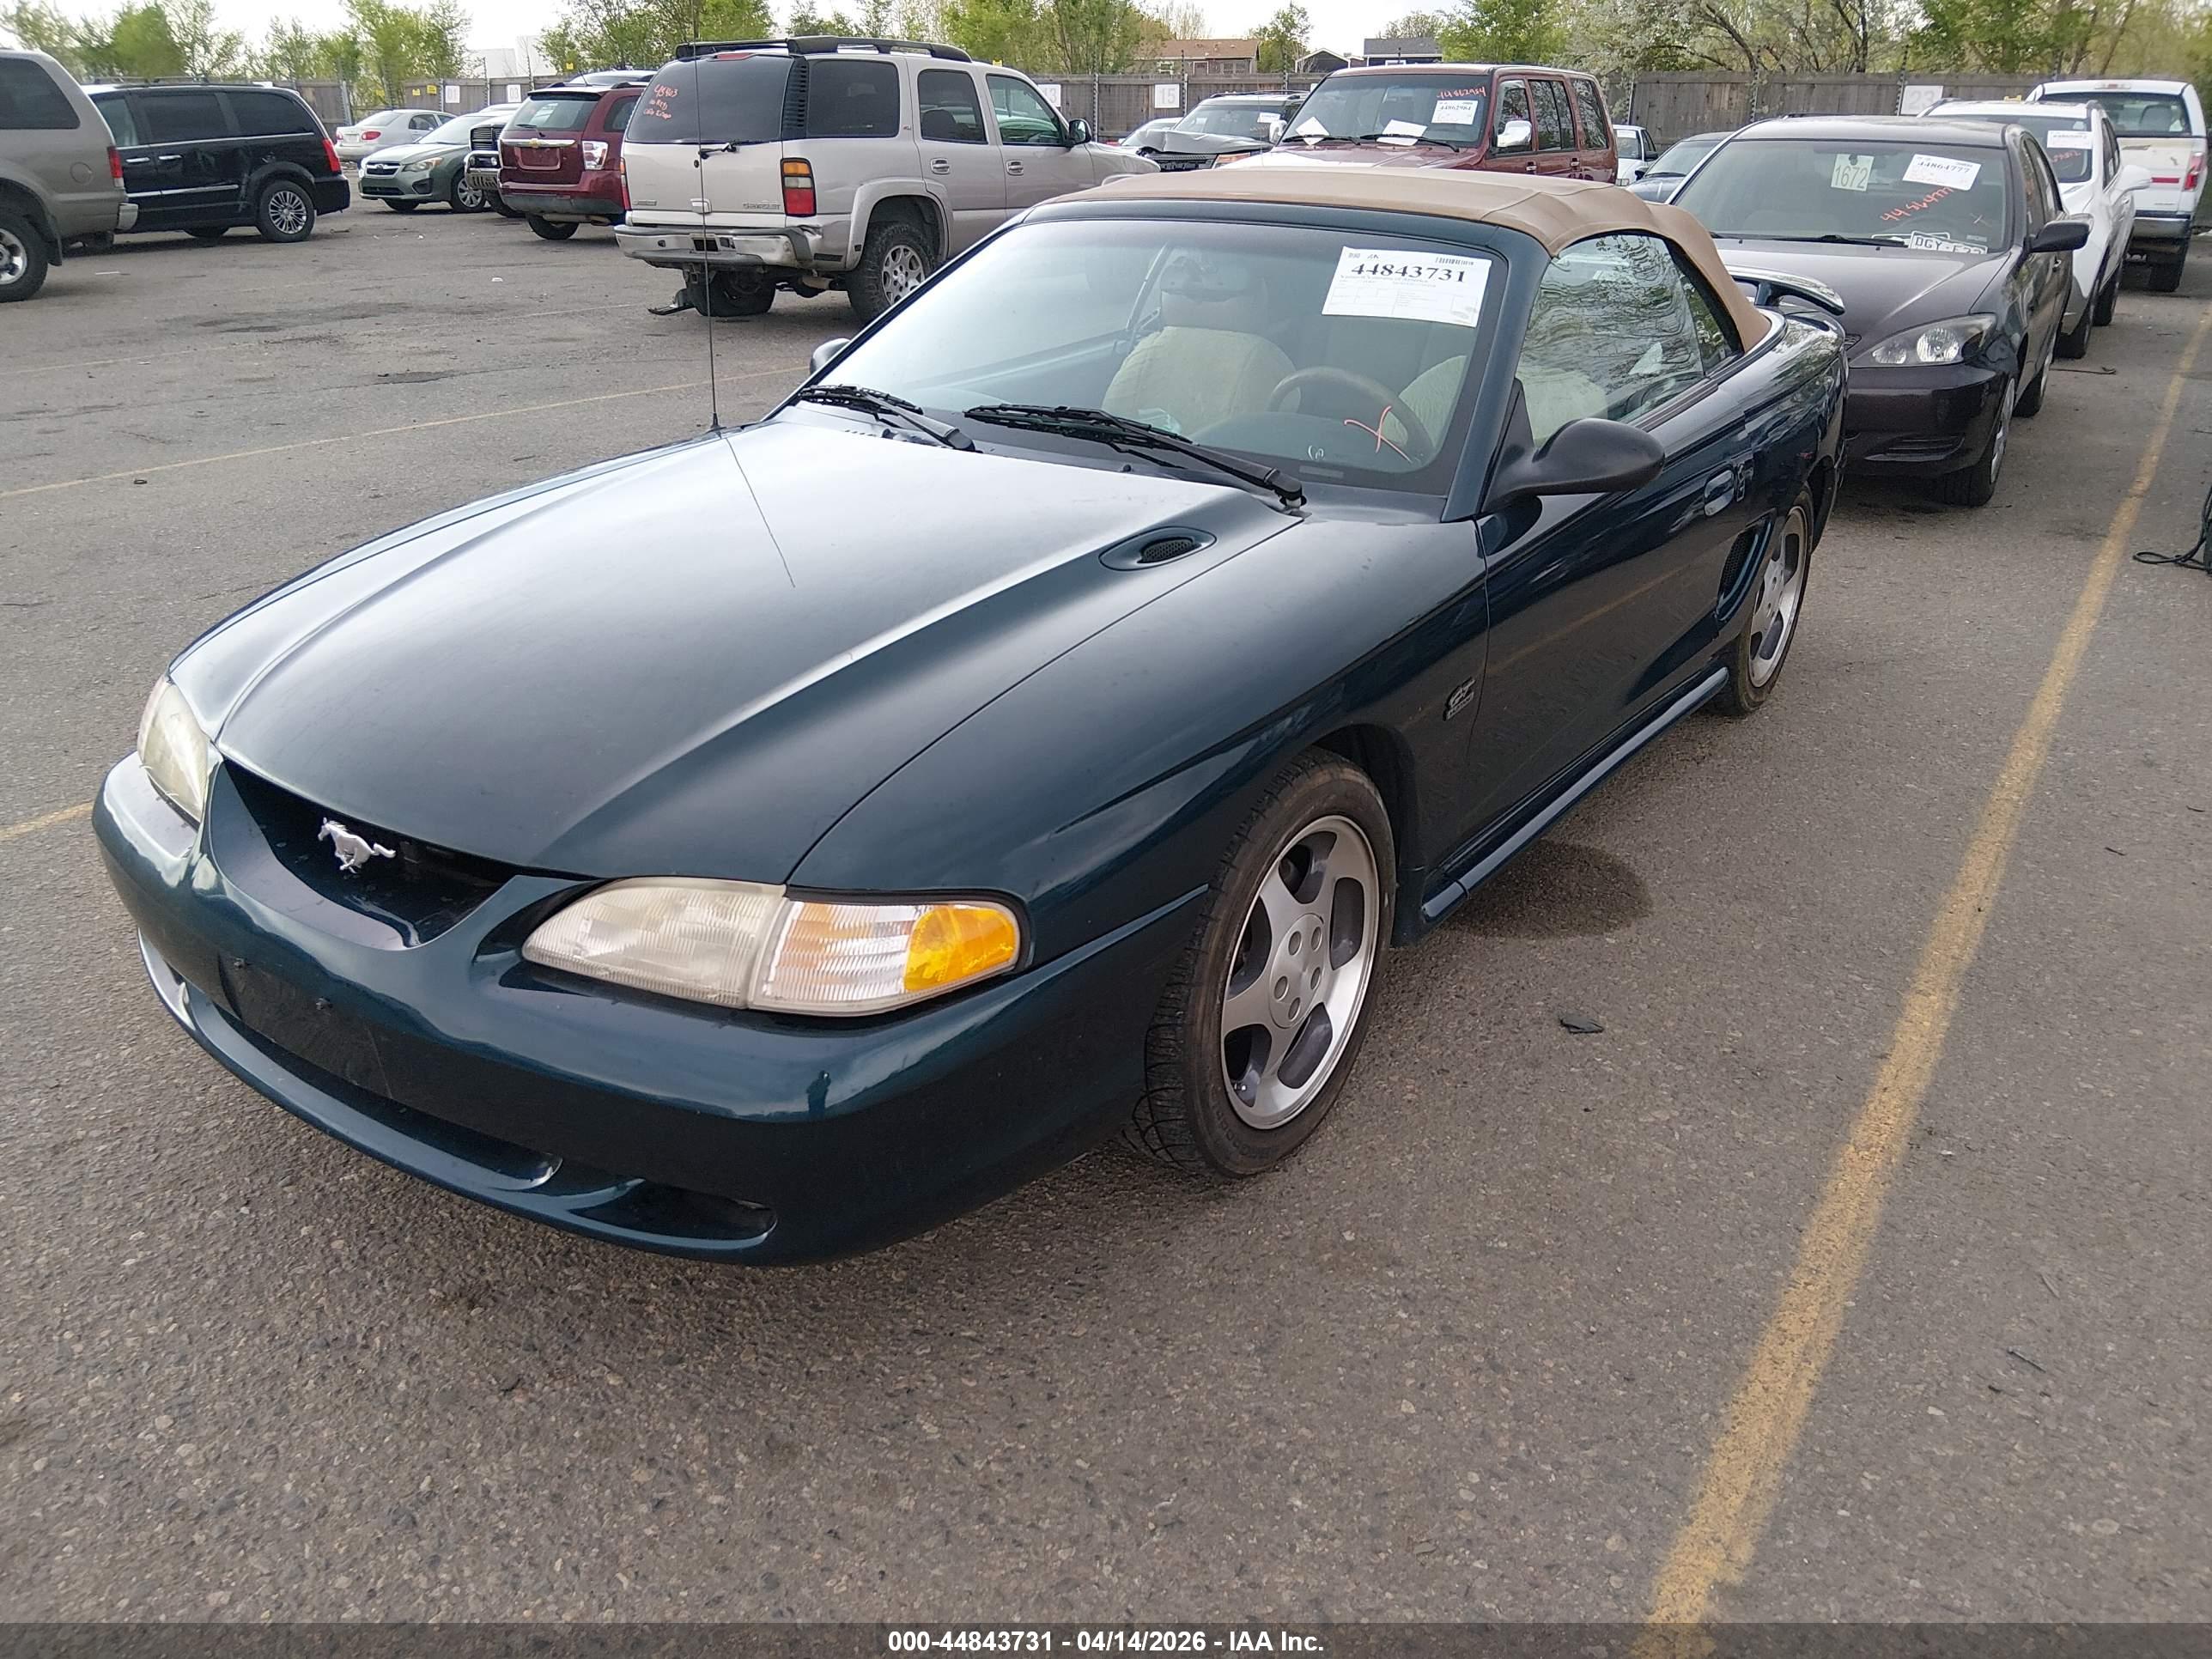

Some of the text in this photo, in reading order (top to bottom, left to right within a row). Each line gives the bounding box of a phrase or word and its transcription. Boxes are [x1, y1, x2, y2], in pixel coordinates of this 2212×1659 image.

[1161, 88, 1176, 104] 15
[1834, 165, 1869, 189] 1672
[1352, 263, 1466, 283] 44843731
